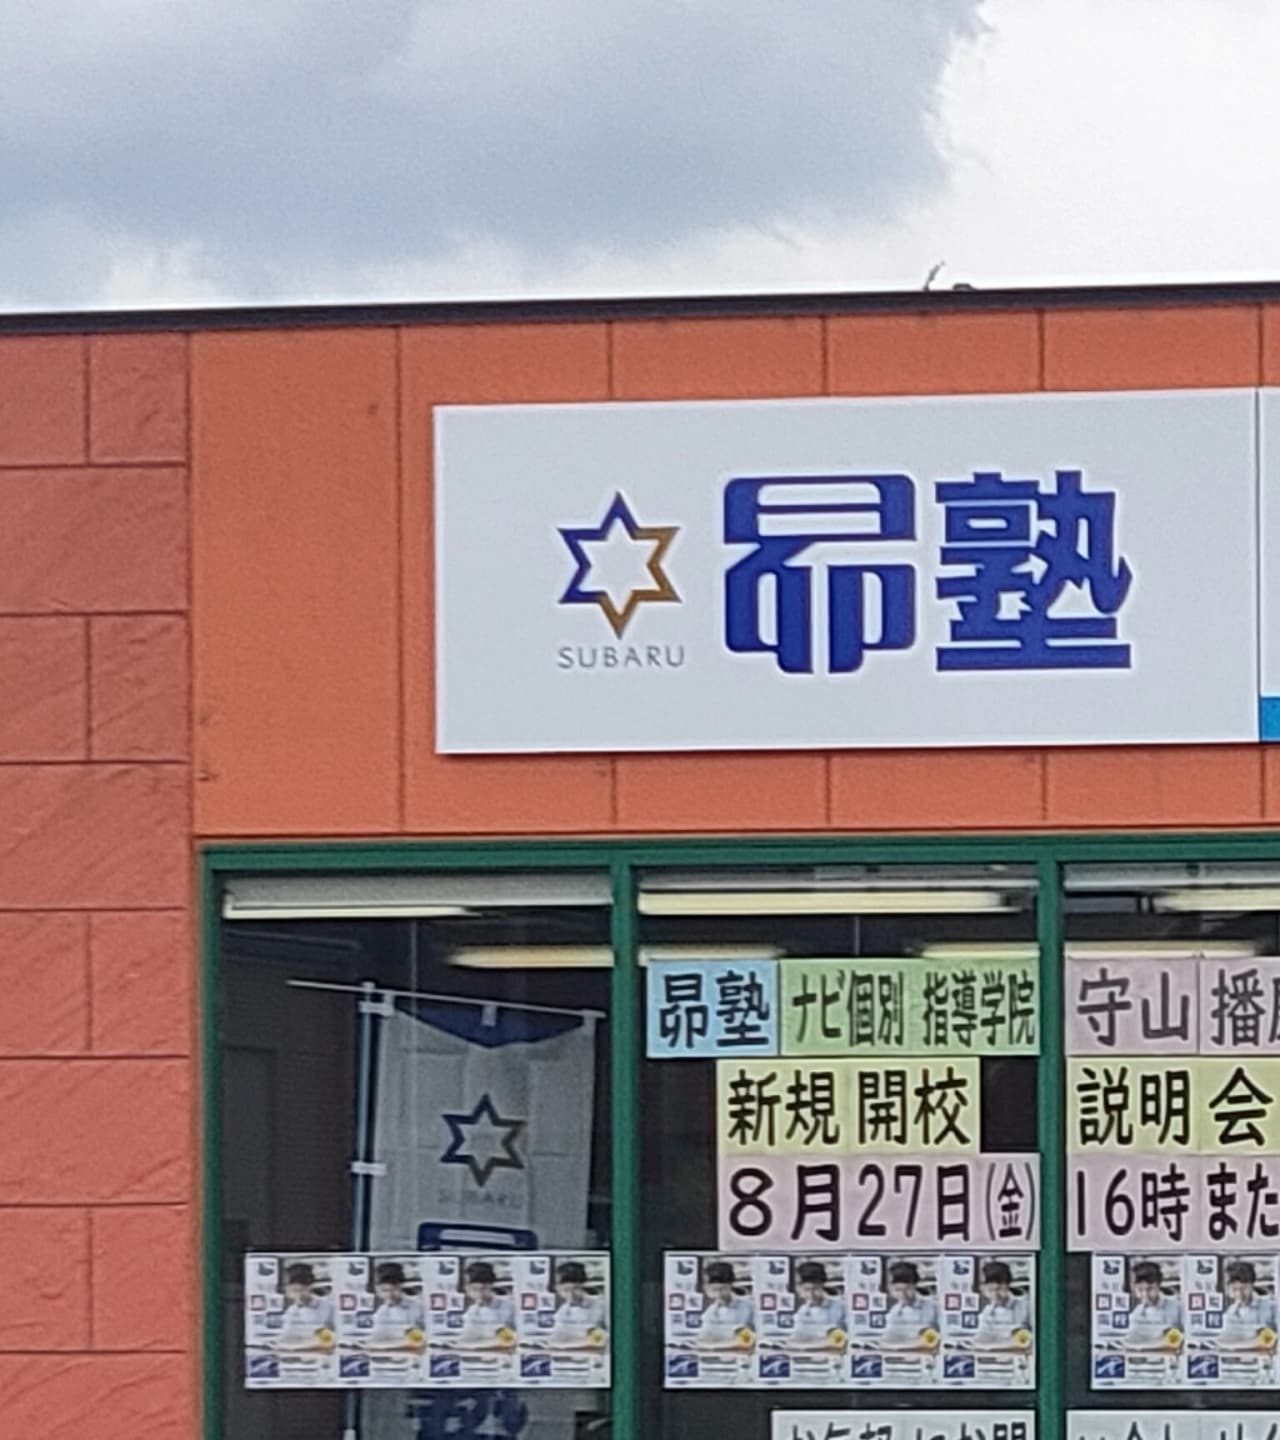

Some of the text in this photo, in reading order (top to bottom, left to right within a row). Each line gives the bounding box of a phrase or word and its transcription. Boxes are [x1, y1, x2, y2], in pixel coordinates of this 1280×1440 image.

[724, 470, 1133, 674] 昴塾
[556, 645, 685, 670] SUBARU
[659, 970, 770, 1048] 昴塾
[727, 1066, 971, 1146] 新規開校
